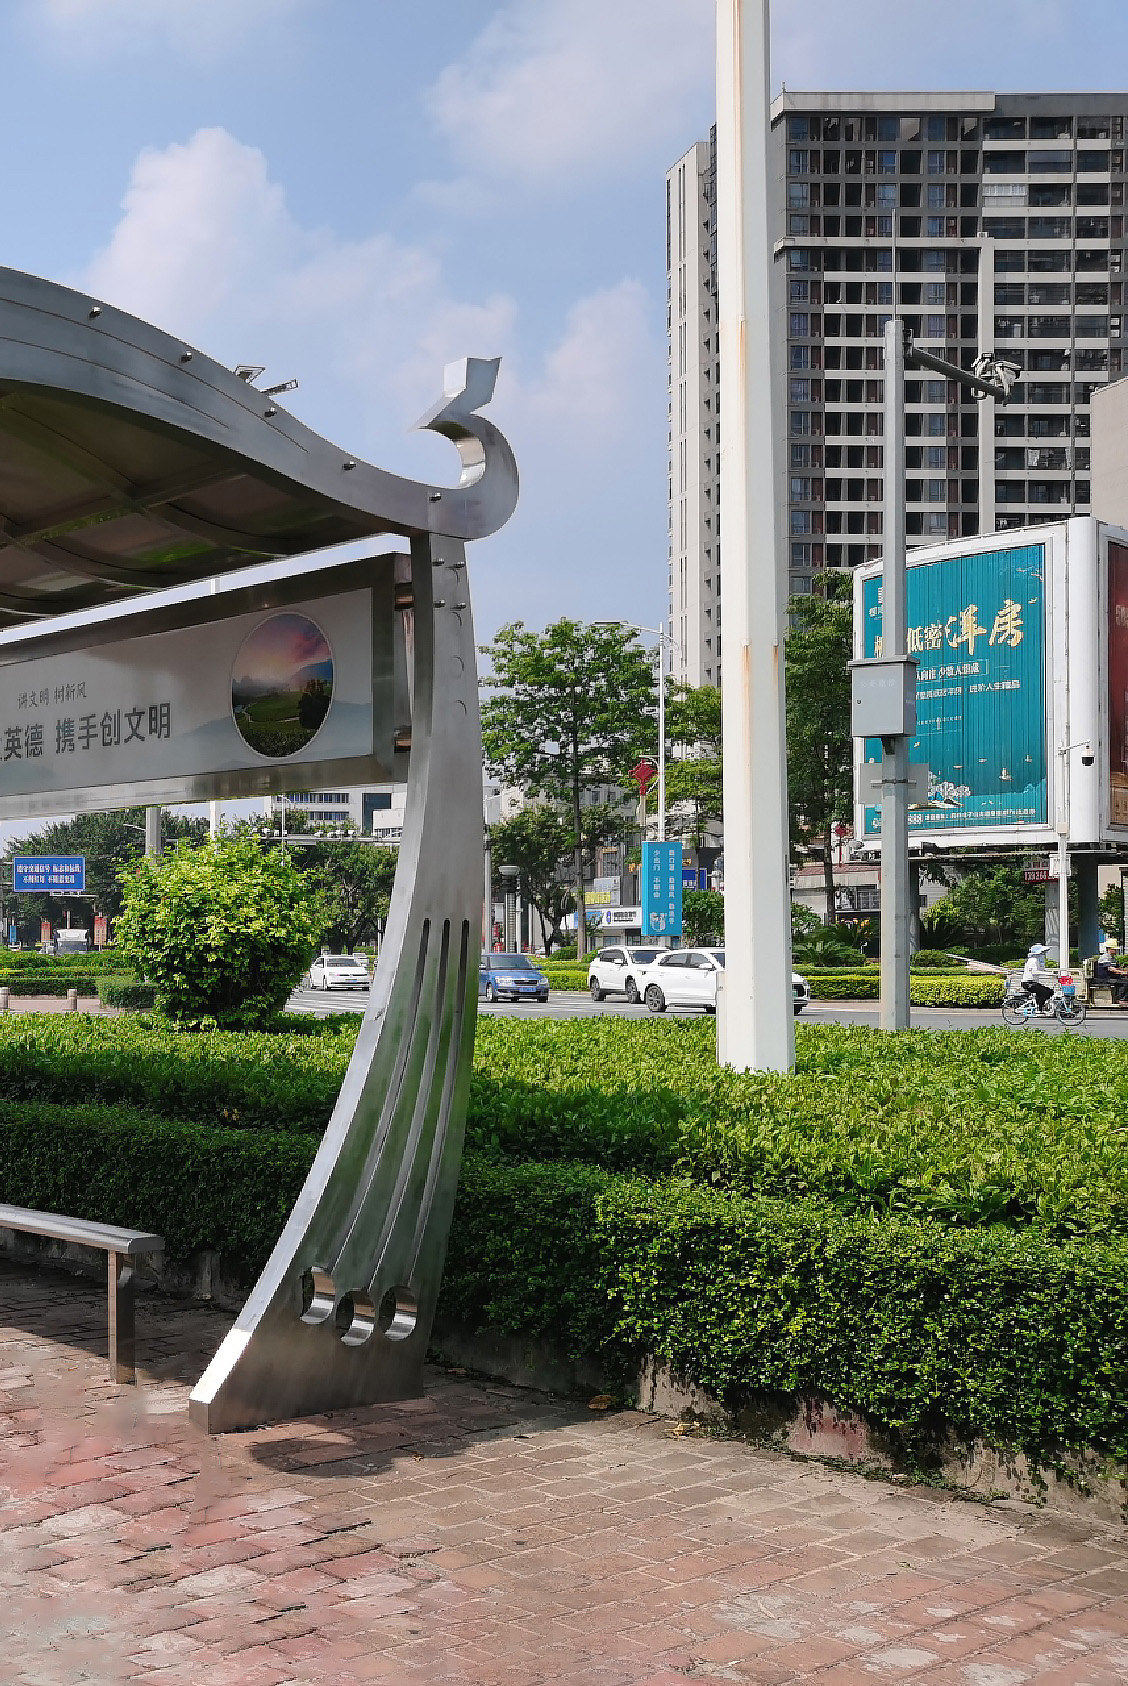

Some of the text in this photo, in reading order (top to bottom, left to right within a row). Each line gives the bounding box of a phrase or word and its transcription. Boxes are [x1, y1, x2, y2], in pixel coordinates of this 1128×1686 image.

[56, 702, 171, 754] 携手创文明
